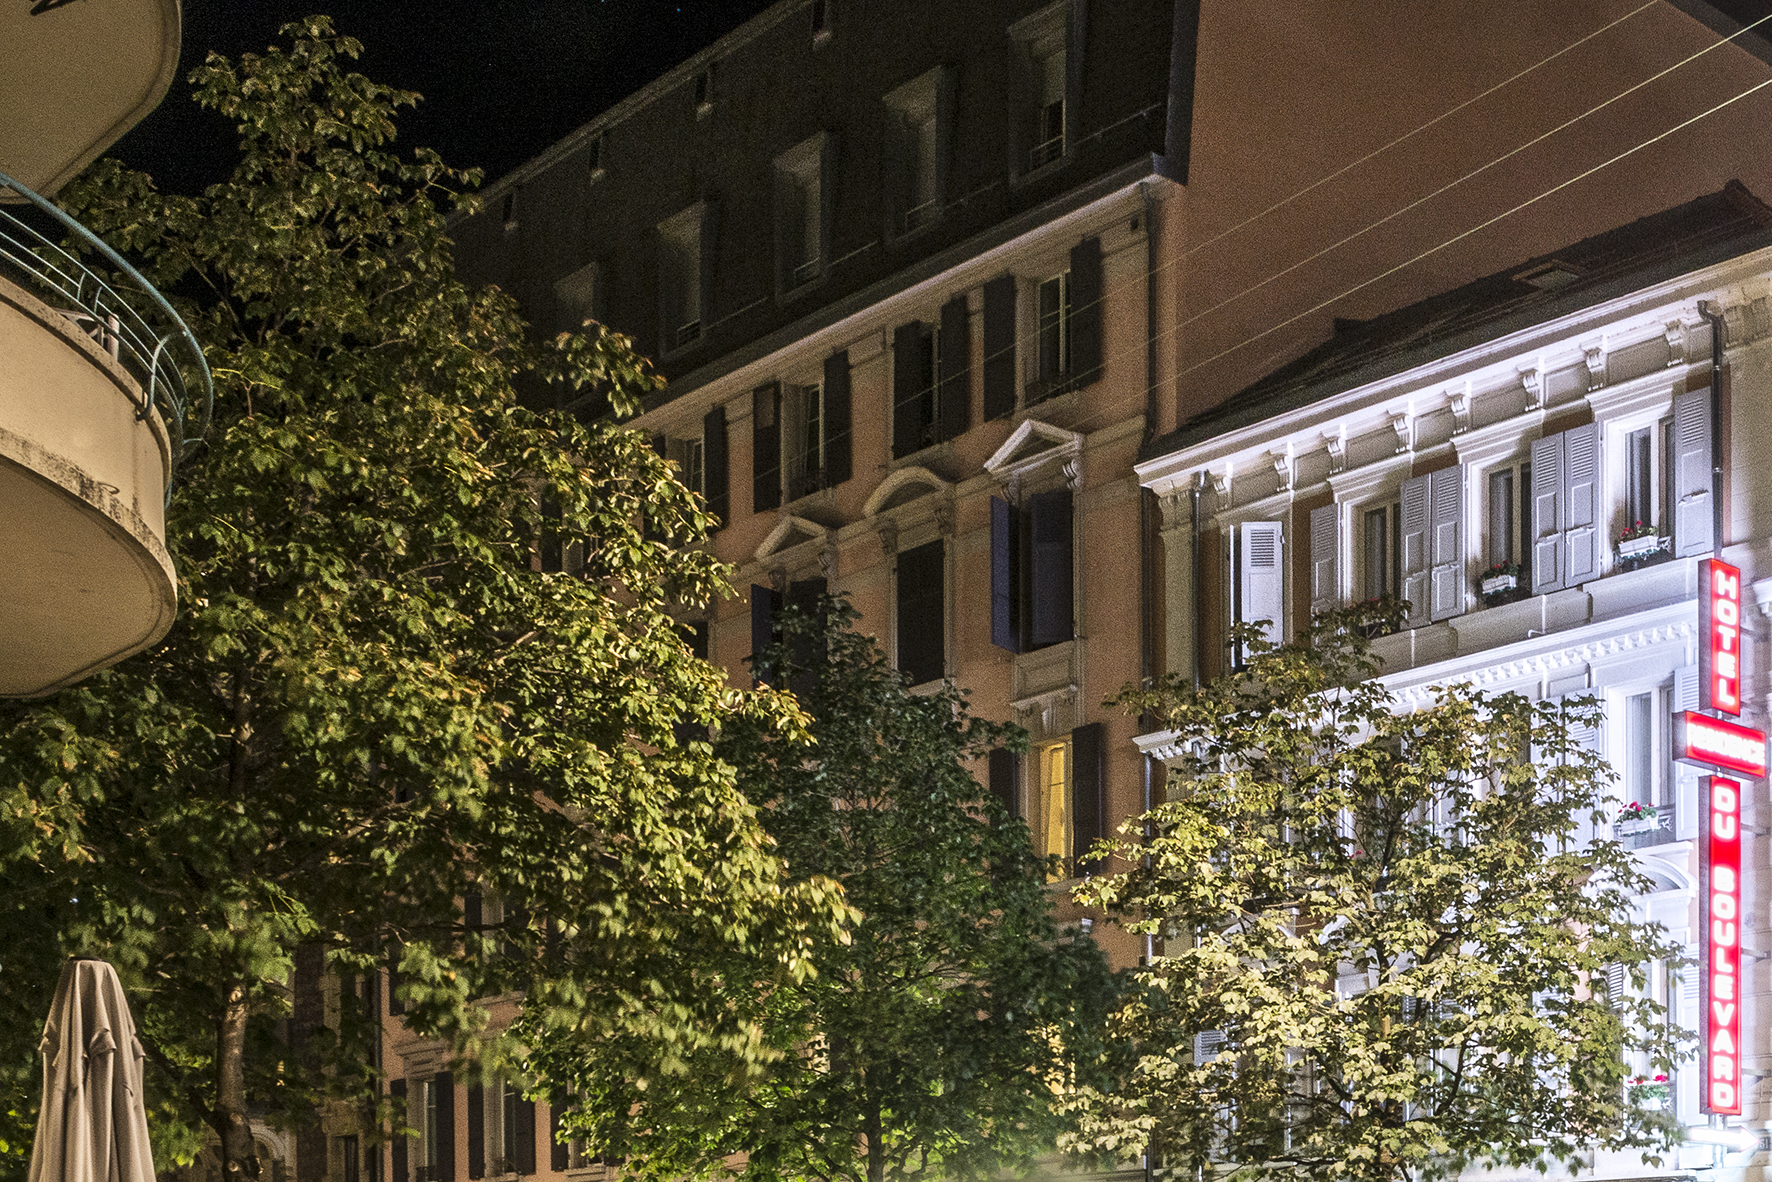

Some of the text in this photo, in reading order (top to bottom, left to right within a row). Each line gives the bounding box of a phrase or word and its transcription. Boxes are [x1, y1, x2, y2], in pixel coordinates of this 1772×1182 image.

[1716, 570, 1737, 706] HOTEL
[1713, 785, 1736, 1109] DU BOULEVARD
